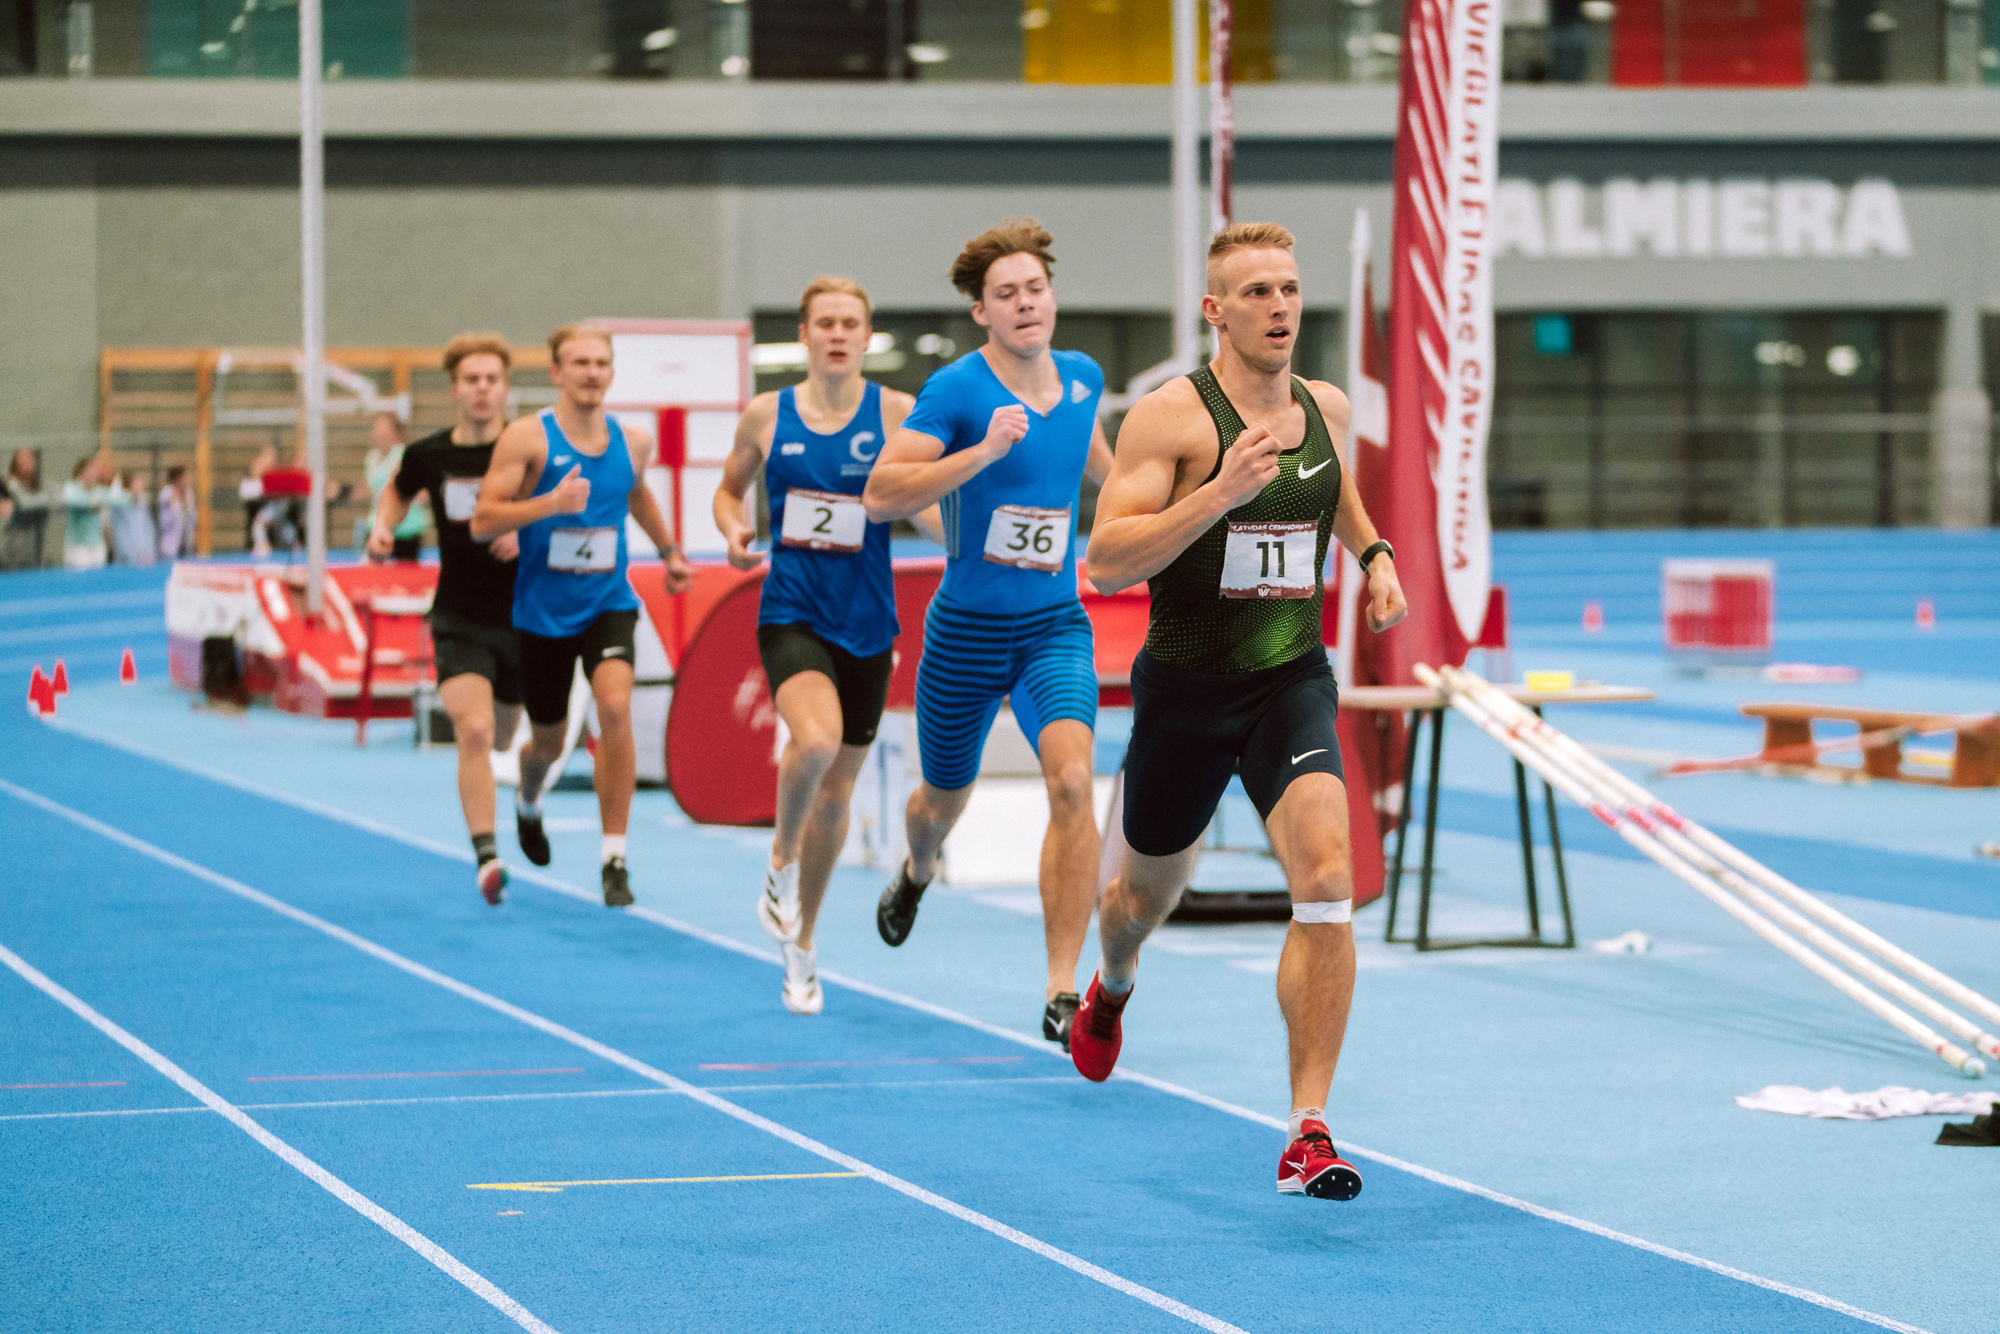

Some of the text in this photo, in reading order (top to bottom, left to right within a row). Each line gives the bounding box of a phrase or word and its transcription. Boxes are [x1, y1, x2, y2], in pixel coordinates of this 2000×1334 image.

[1494, 179, 1910, 257] ALMIERA
[812, 507, 833, 534] 2
[575, 536, 594, 561] 4
[1006, 522, 1054, 554] 36
[1256, 541, 1285, 578] 11
